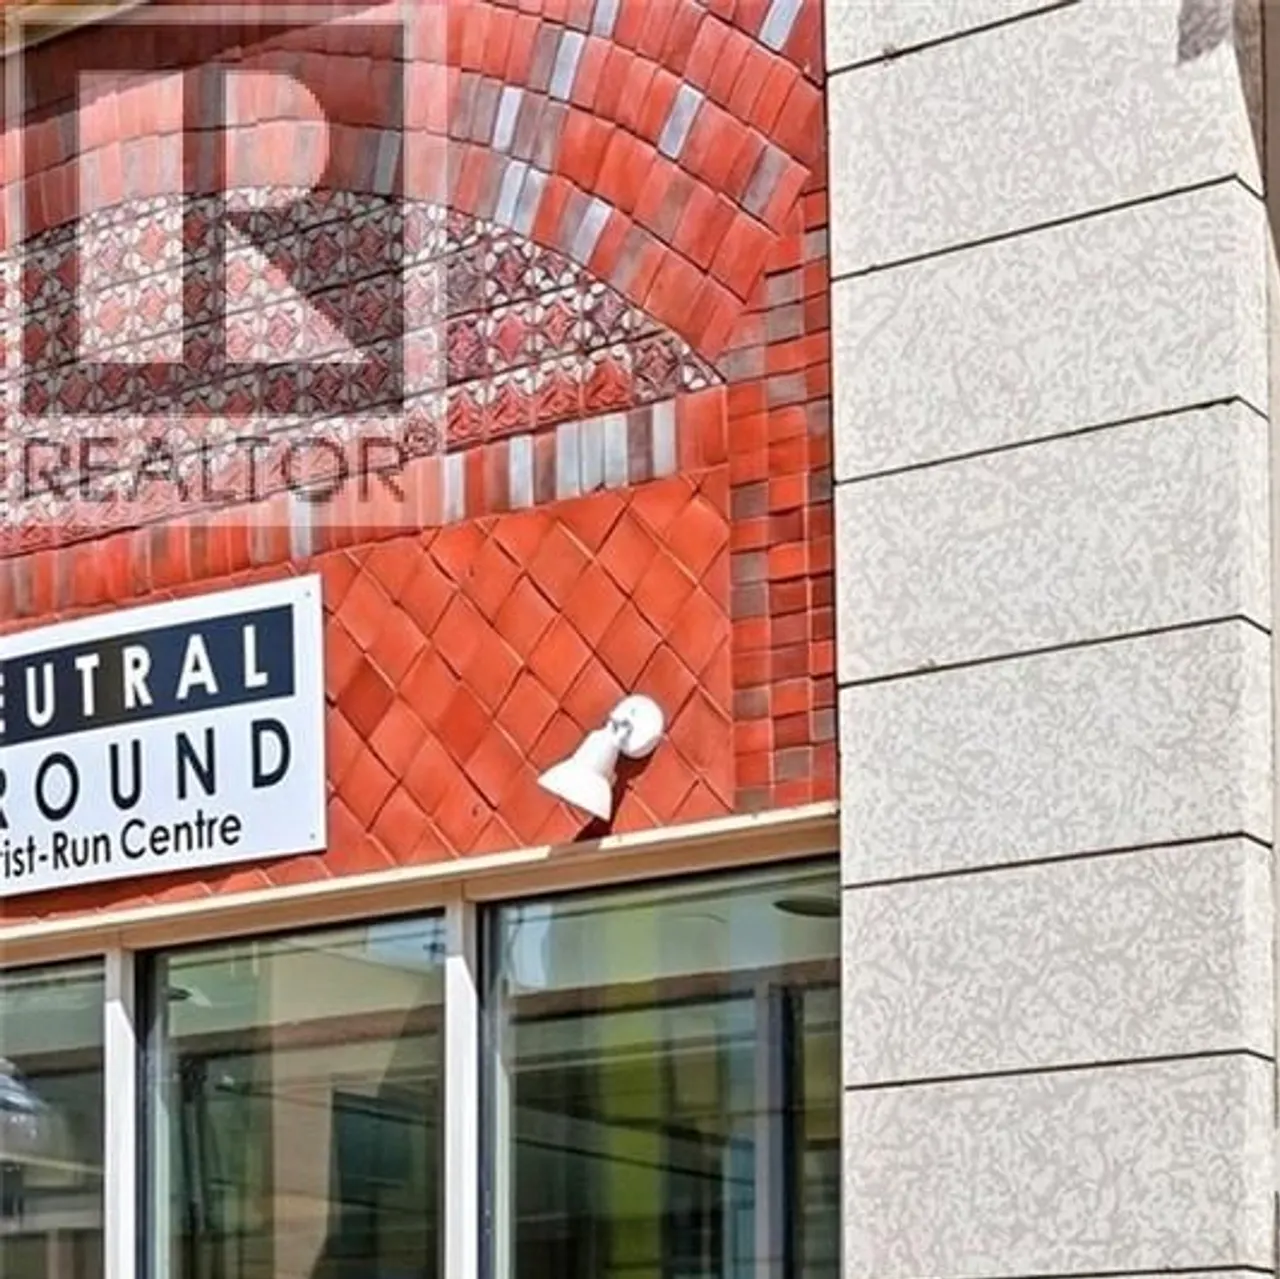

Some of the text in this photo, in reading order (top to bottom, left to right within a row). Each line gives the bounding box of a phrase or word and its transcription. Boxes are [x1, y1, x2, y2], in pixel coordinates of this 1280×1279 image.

[0, 625, 268, 733] UTRAL
[0, 717, 291, 830] OUND
[0, 810, 241, 878] ist-Run Centre
